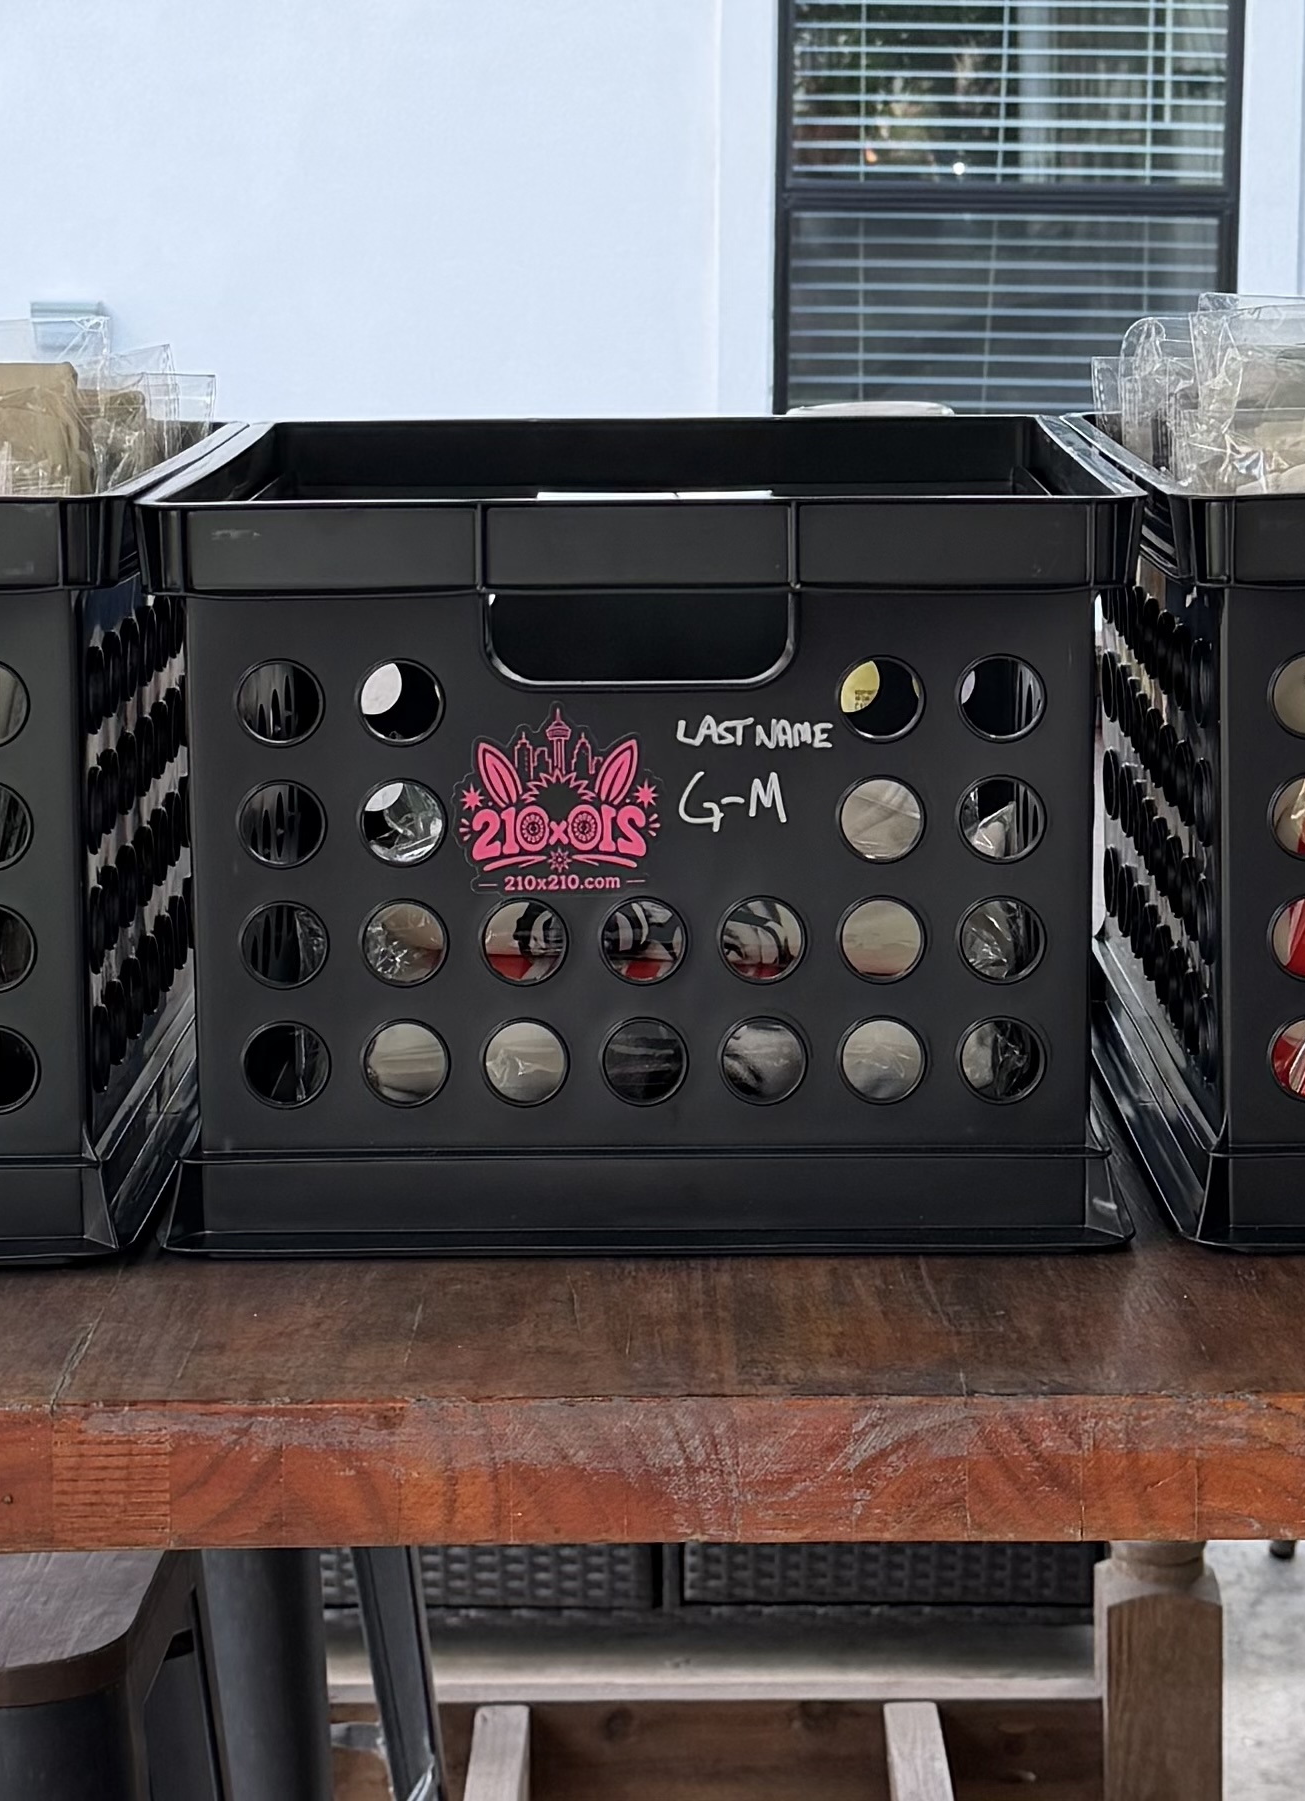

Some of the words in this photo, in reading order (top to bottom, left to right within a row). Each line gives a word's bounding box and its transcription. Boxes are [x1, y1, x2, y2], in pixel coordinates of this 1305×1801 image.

[676, 714, 754, 747] LAST
[755, 718, 834, 749] NAME
[678, 771, 787, 833] G-M
[504, 875, 621, 891] 210x210.com
